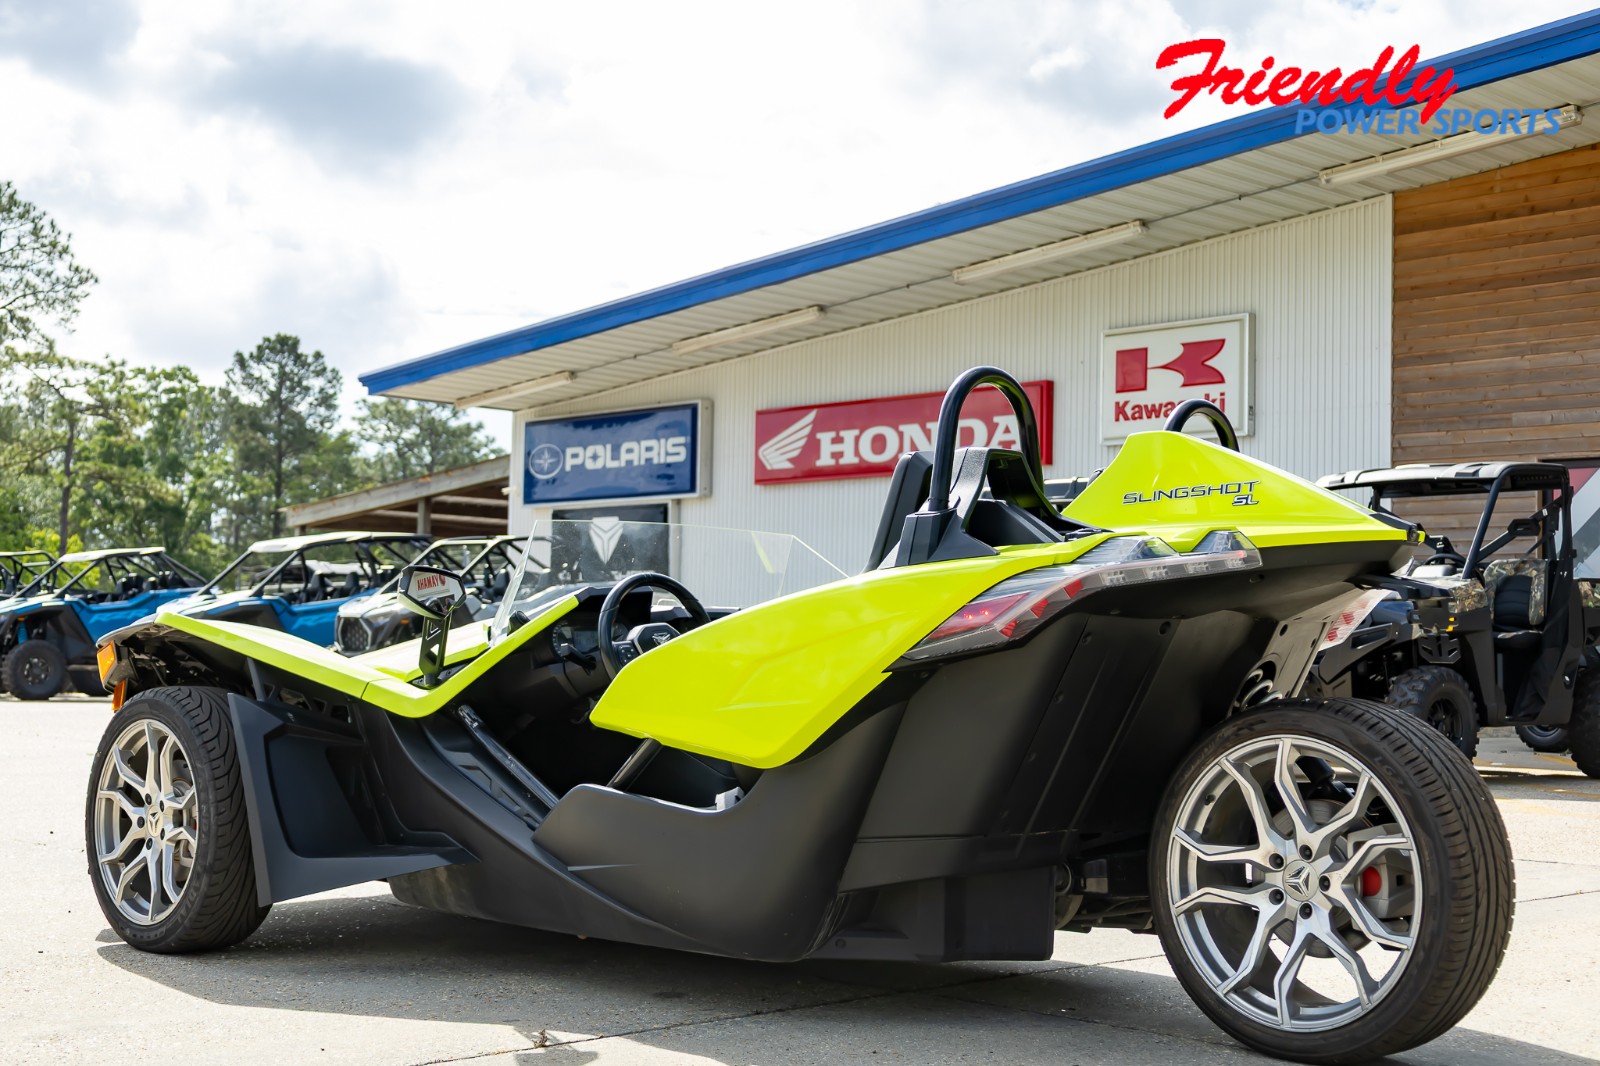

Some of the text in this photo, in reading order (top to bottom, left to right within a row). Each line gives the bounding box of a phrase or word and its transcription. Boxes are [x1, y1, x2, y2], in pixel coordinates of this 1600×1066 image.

[1114, 392, 1226, 422] Kawai
[564, 436, 687, 472] POLARIS
[815, 414, 1023, 467] HONDA
[1122, 480, 1260, 504] SLINGSHOT
[1232, 493, 1259, 506] SL
